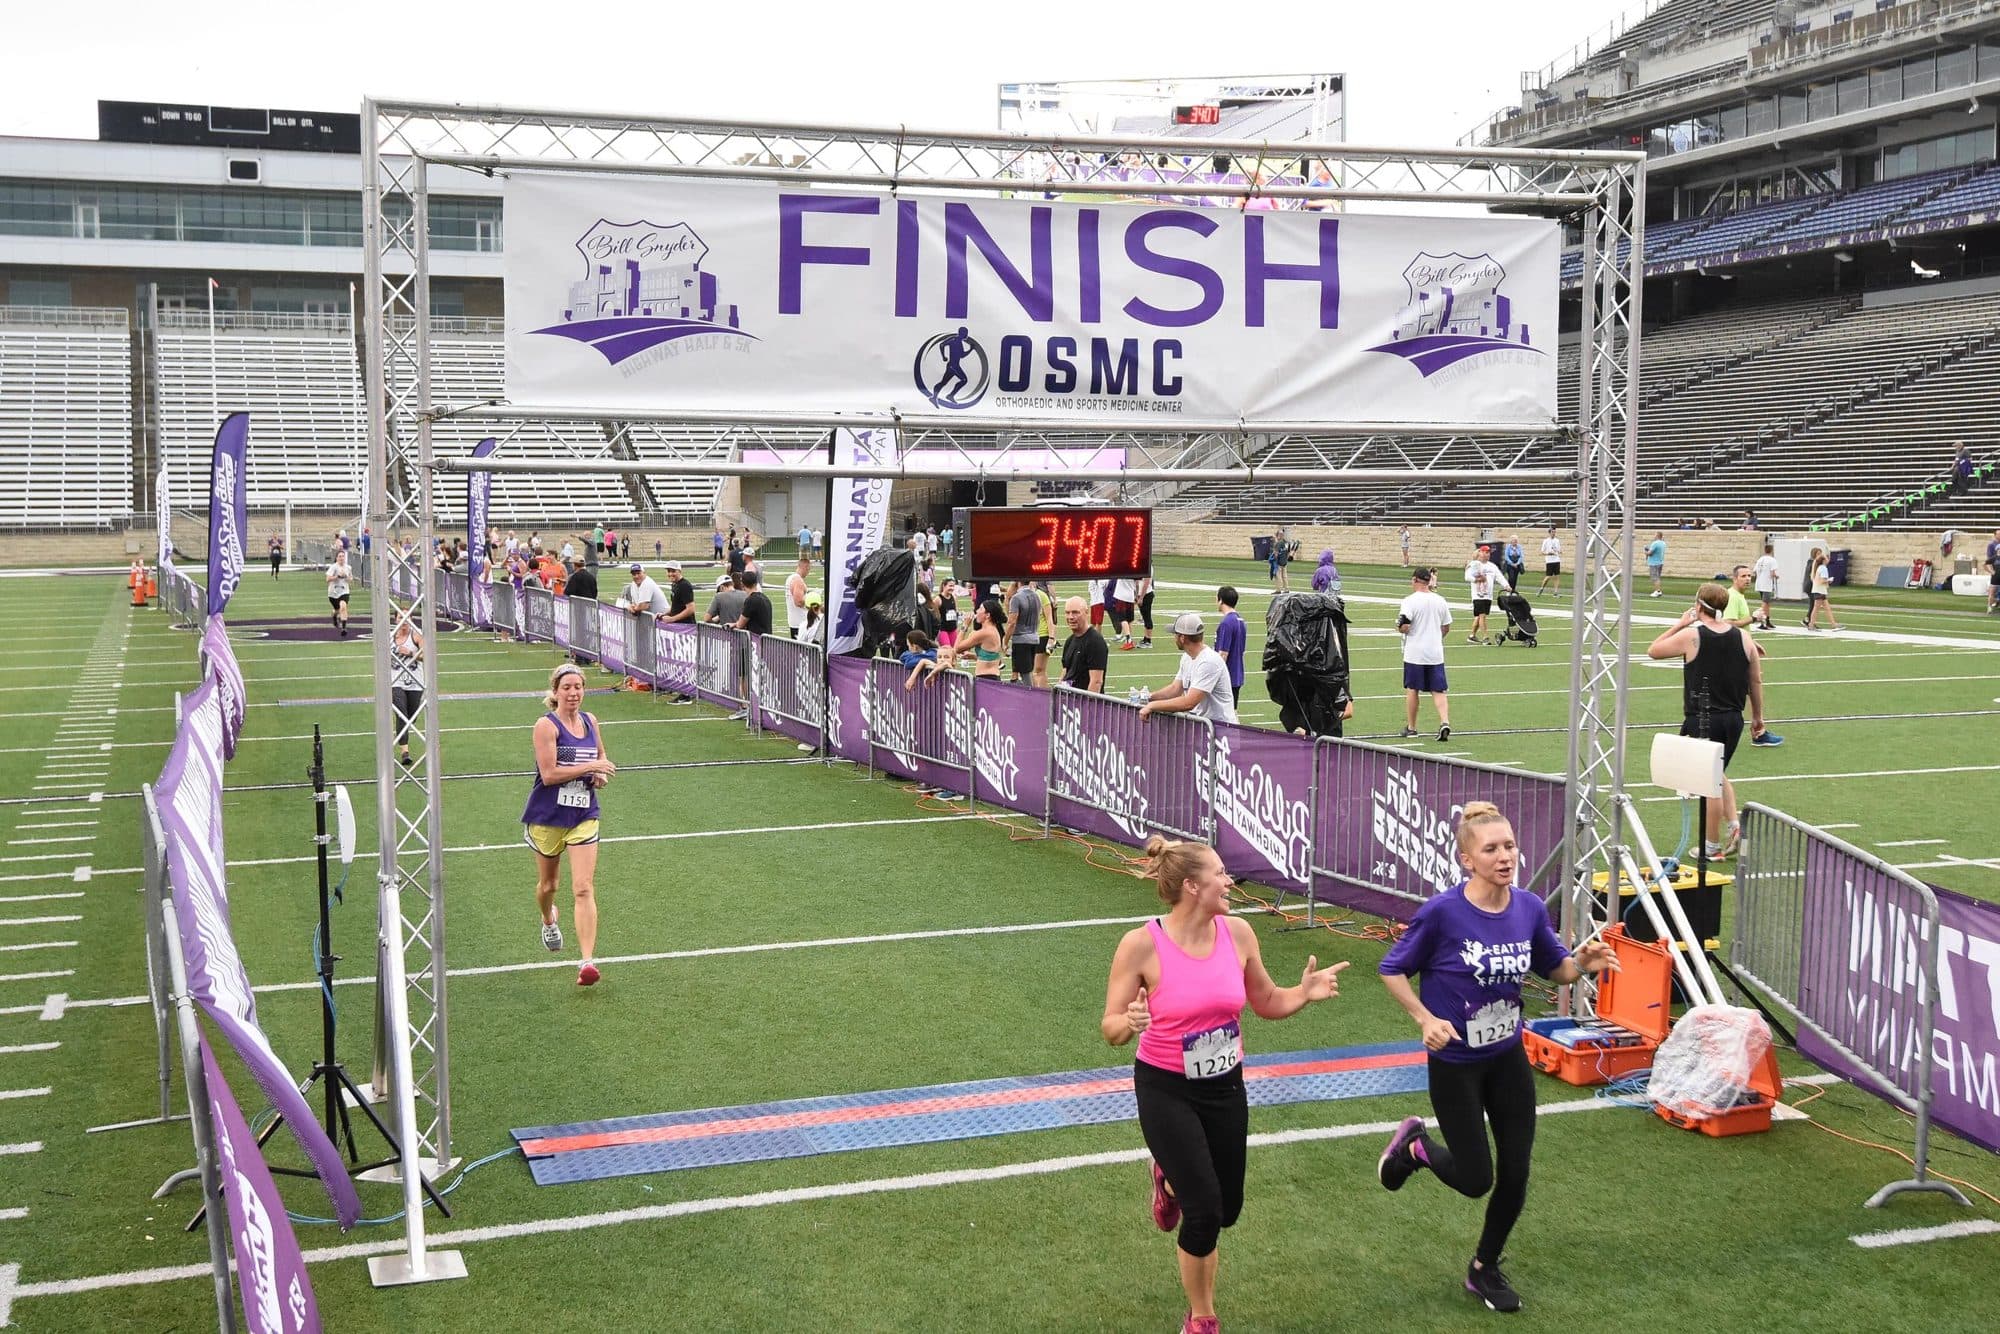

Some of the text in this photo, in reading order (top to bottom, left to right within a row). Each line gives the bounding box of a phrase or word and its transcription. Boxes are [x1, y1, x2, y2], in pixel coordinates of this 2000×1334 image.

[162, 110, 180, 120] DOWN
[185, 112, 202, 121] TO GO
[273, 117, 287, 126] BALL
[587, 232, 696, 261] Bill Snyder
[778, 193, 1340, 330] FINISH
[1411, 263, 1500, 287] Bill Snyder
[619, 341, 681, 379] HIGHWAY
[684, 336, 719, 352] HALF
[998, 334, 1183, 396] OSMC
[1429, 358, 1480, 389] HIGHWAY
[995, 397, 1182, 413] ORTHOPAEDIC AND SPORTS MEDICINE CENTER
[843, 412, 873, 599] MANHATTA
[1031, 511, 1145, 572] 34:07
[562, 794, 588, 807] 1150
[1492, 943, 1515, 955] EAT
[1475, 1018, 1516, 1045] 1224
[1193, 1049, 1236, 1077] 1226
